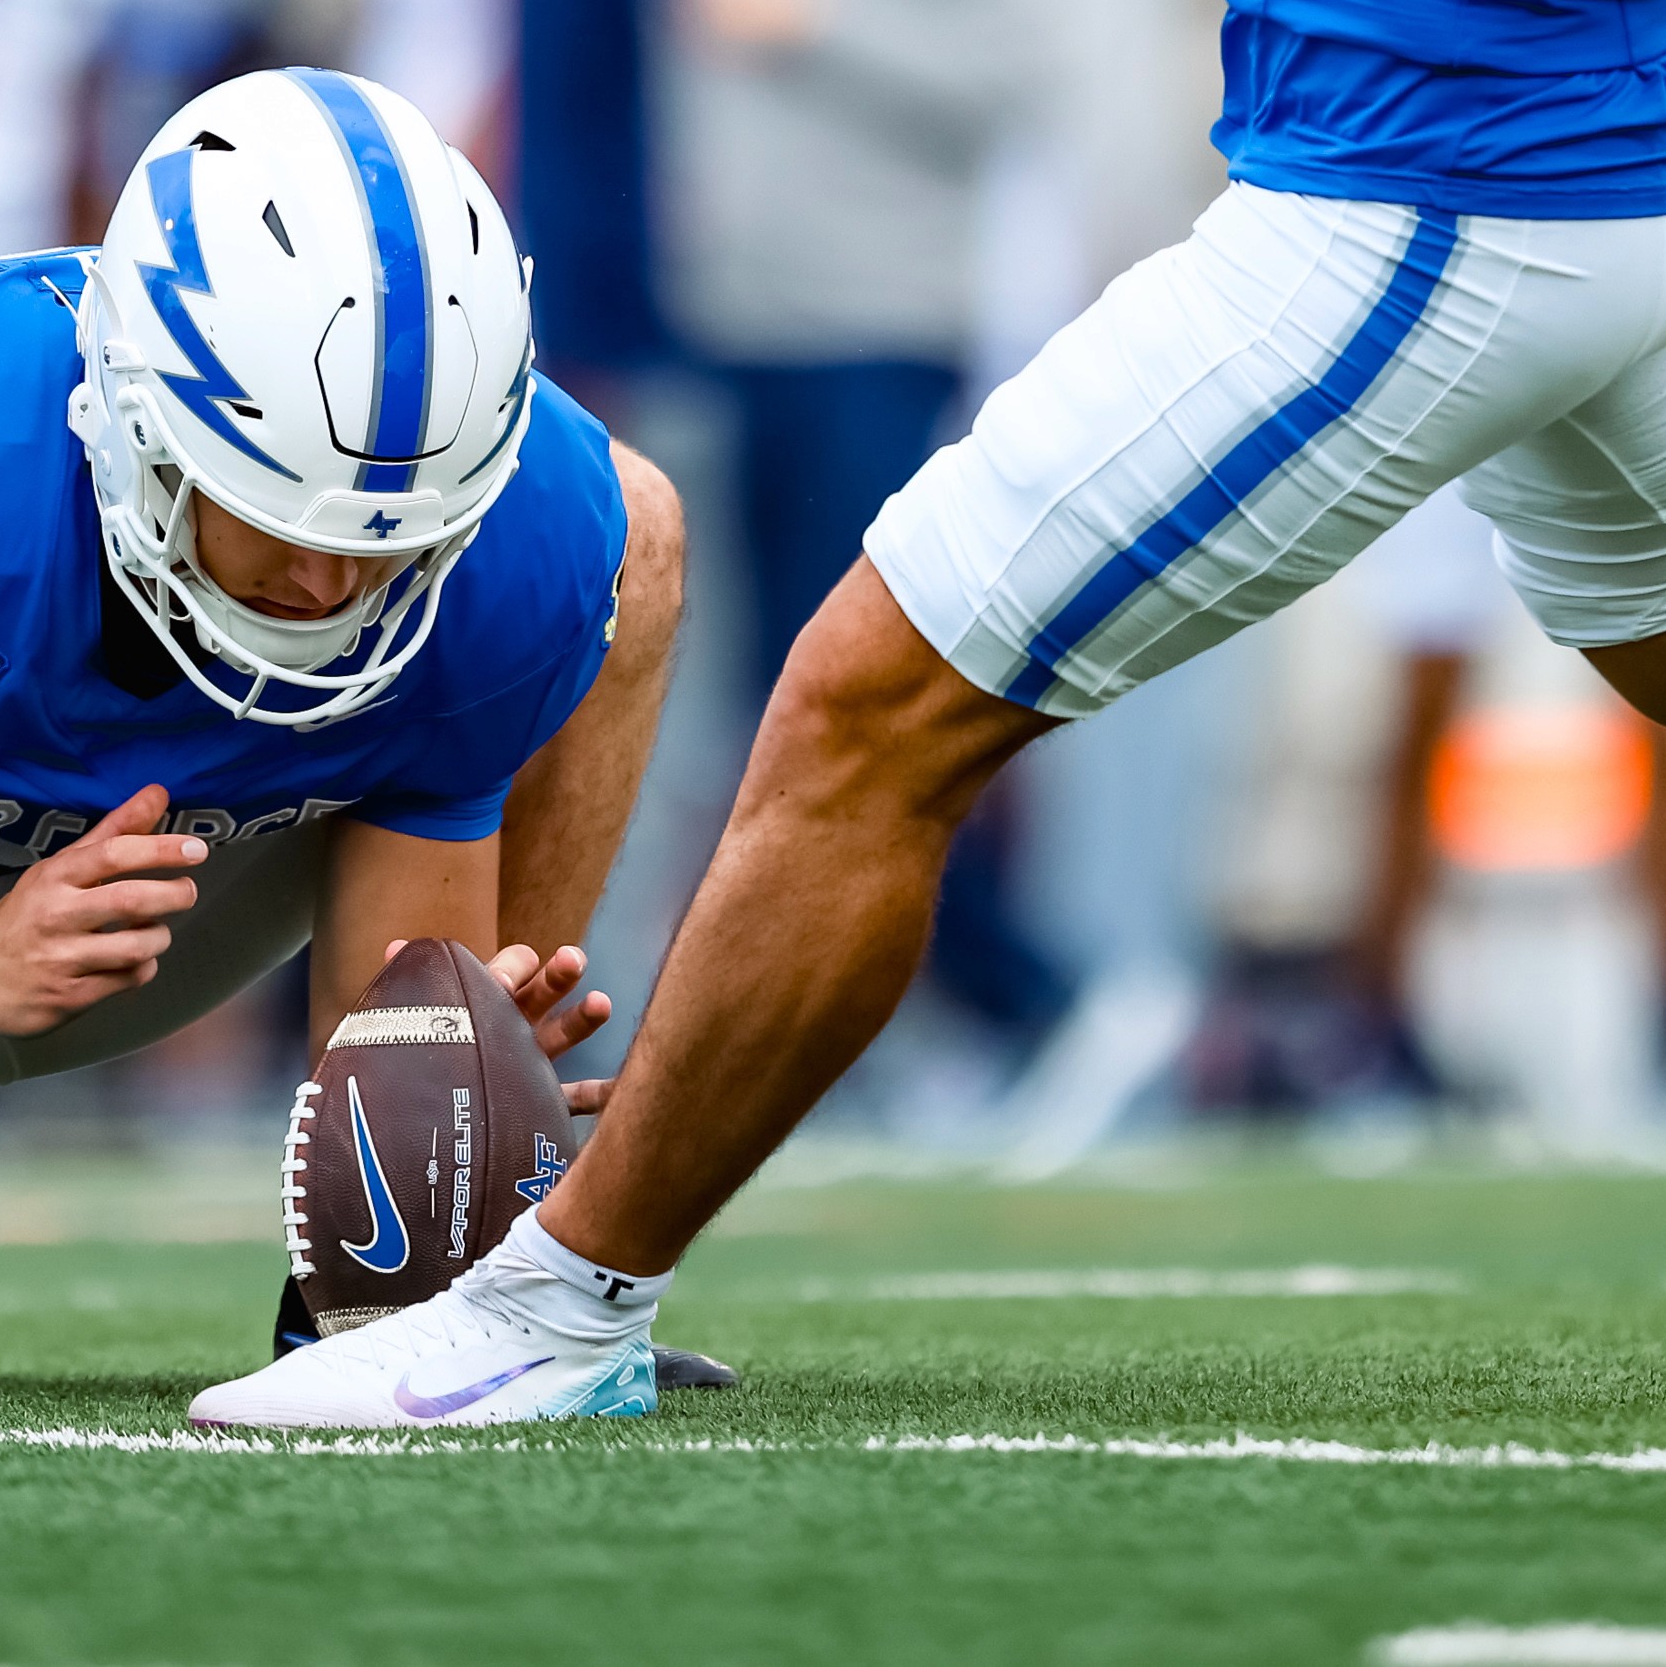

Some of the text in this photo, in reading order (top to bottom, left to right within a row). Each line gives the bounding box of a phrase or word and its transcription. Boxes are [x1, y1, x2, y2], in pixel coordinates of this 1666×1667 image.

[426, 1160, 440, 1184] USA
[447, 1088, 471, 1259] VAPOR ELITE
